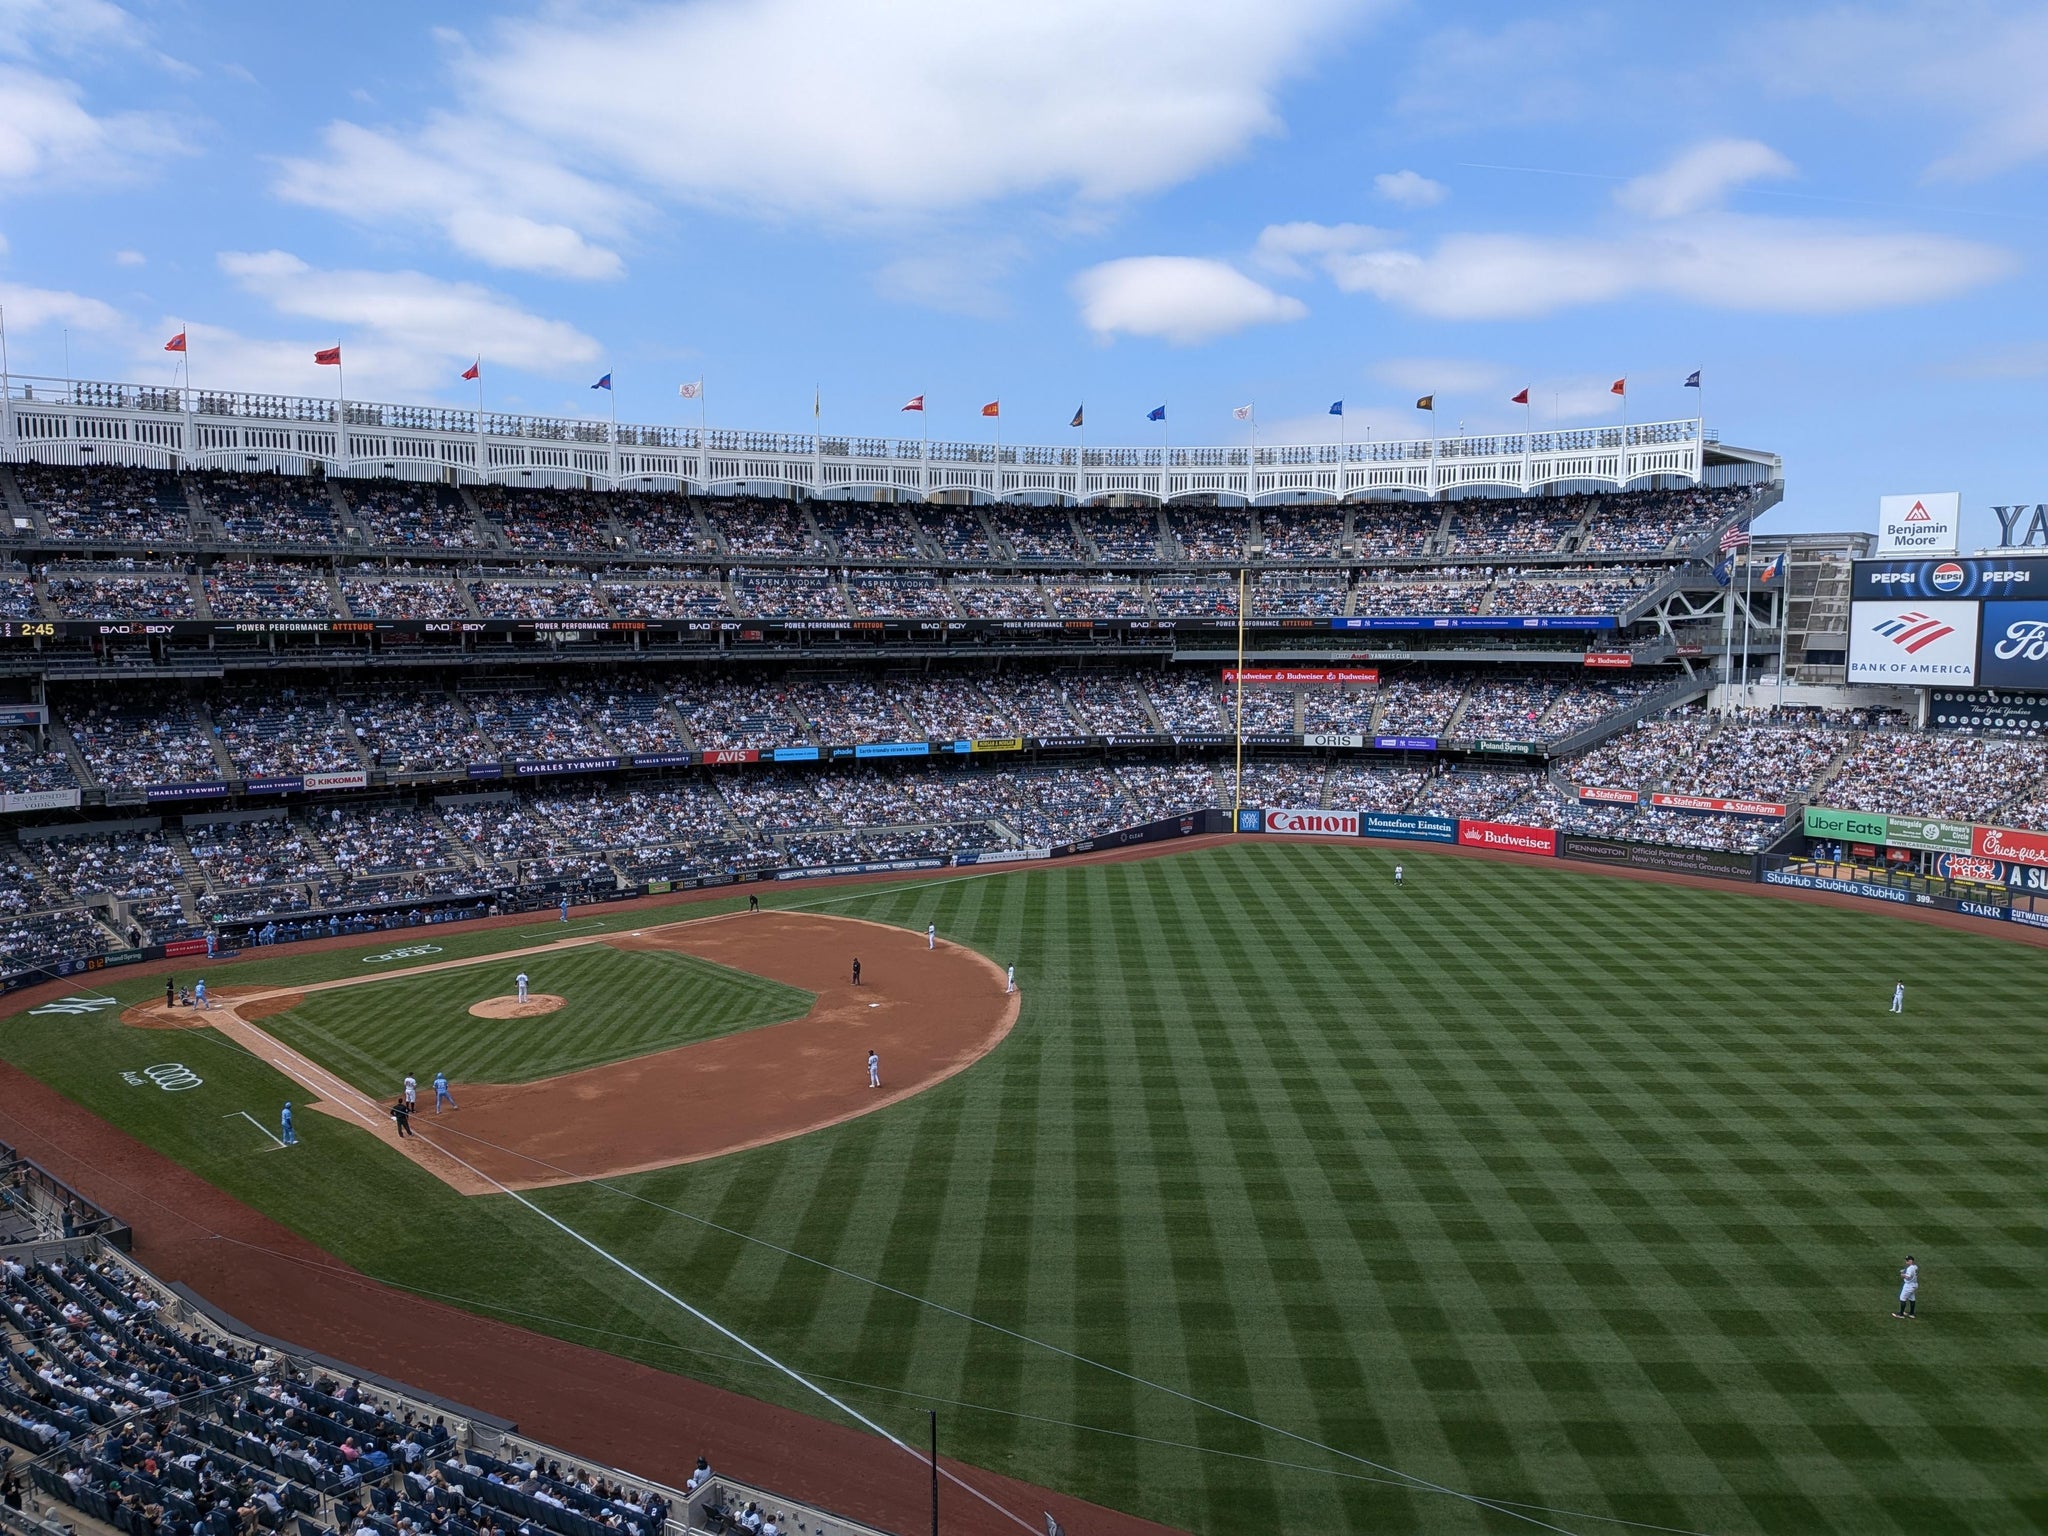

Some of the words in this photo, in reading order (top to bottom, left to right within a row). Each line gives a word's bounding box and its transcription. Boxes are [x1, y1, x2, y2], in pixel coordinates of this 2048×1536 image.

[1888, 522, 1947, 538] Benjamin
[1894, 536, 1936, 546] Moore
[1871, 572, 1915, 583] PEPSI
[1934, 574, 1962, 582] PEPSI
[1982, 570, 2030, 582] PEPSI
[748, 578, 780, 587] ASPEN
[791, 579, 822, 587] VODKA
[902, 580, 930, 588] VODKA
[22, 624, 54, 636] 2:45
[236, 624, 268, 632] POWER.
[270, 624, 330, 632] PERFORMANCE.
[332, 622, 374, 631] ATTITUDE
[1852, 663, 1886, 673] BANK
[1890, 664, 1906, 673] OF
[1910, 664, 1971, 675] AMERICA
[1986, 706, 2002, 716] York
[2002, 707, 2031, 717] Yankees
[1315, 735, 1350, 746] ORIS
[833, 749, 853, 757] phade
[1481, 741, 1504, 751] Poland
[1504, 743, 1529, 754] Spring
[716, 750, 746, 762] AVIS
[520, 763, 563, 773] CHARLES
[566, 760, 617, 770] TYRWHITT
[318, 776, 363, 786] KIKKOMAN
[148, 789, 183, 797] CHARLES
[186, 786, 226, 794] TYRWHITT
[1266, 811, 1357, 833] Canon
[1368, 818, 1416, 828] Montefiore
[1418, 821, 1451, 832] Einstein
[1808, 815, 1844, 831] Uber
[1847, 819, 1882, 835] Eats
[1889, 818, 1922, 828] Morningside
[1940, 823, 1970, 833] Workmen's
[1952, 832, 1969, 840] Circle
[1569, 844, 1625, 856] PENNINGTON
[1632, 847, 1657, 856] Official
[1658, 850, 1685, 859] Partner
[1650, 856, 1666, 865] York
[1667, 859, 1697, 869] Yankees
[1699, 863, 1730, 873] Grounds
[1731, 867, 1752, 875] Crew
[1946, 854, 1995, 871] Jersey
[2010, 866, 2022, 886] A
[1767, 873, 1810, 887] StubHub
[1815, 879, 1858, 894] StubHub
[1862, 886, 1905, 901] StubHub
[1916, 895, 1930, 903] 399
[1961, 902, 2001, 918] STARR
[2012, 910, 2048, 923] CUTWATER
[118, 1071, 148, 1086] Audi
[651, 1507, 657, 1516] 2
